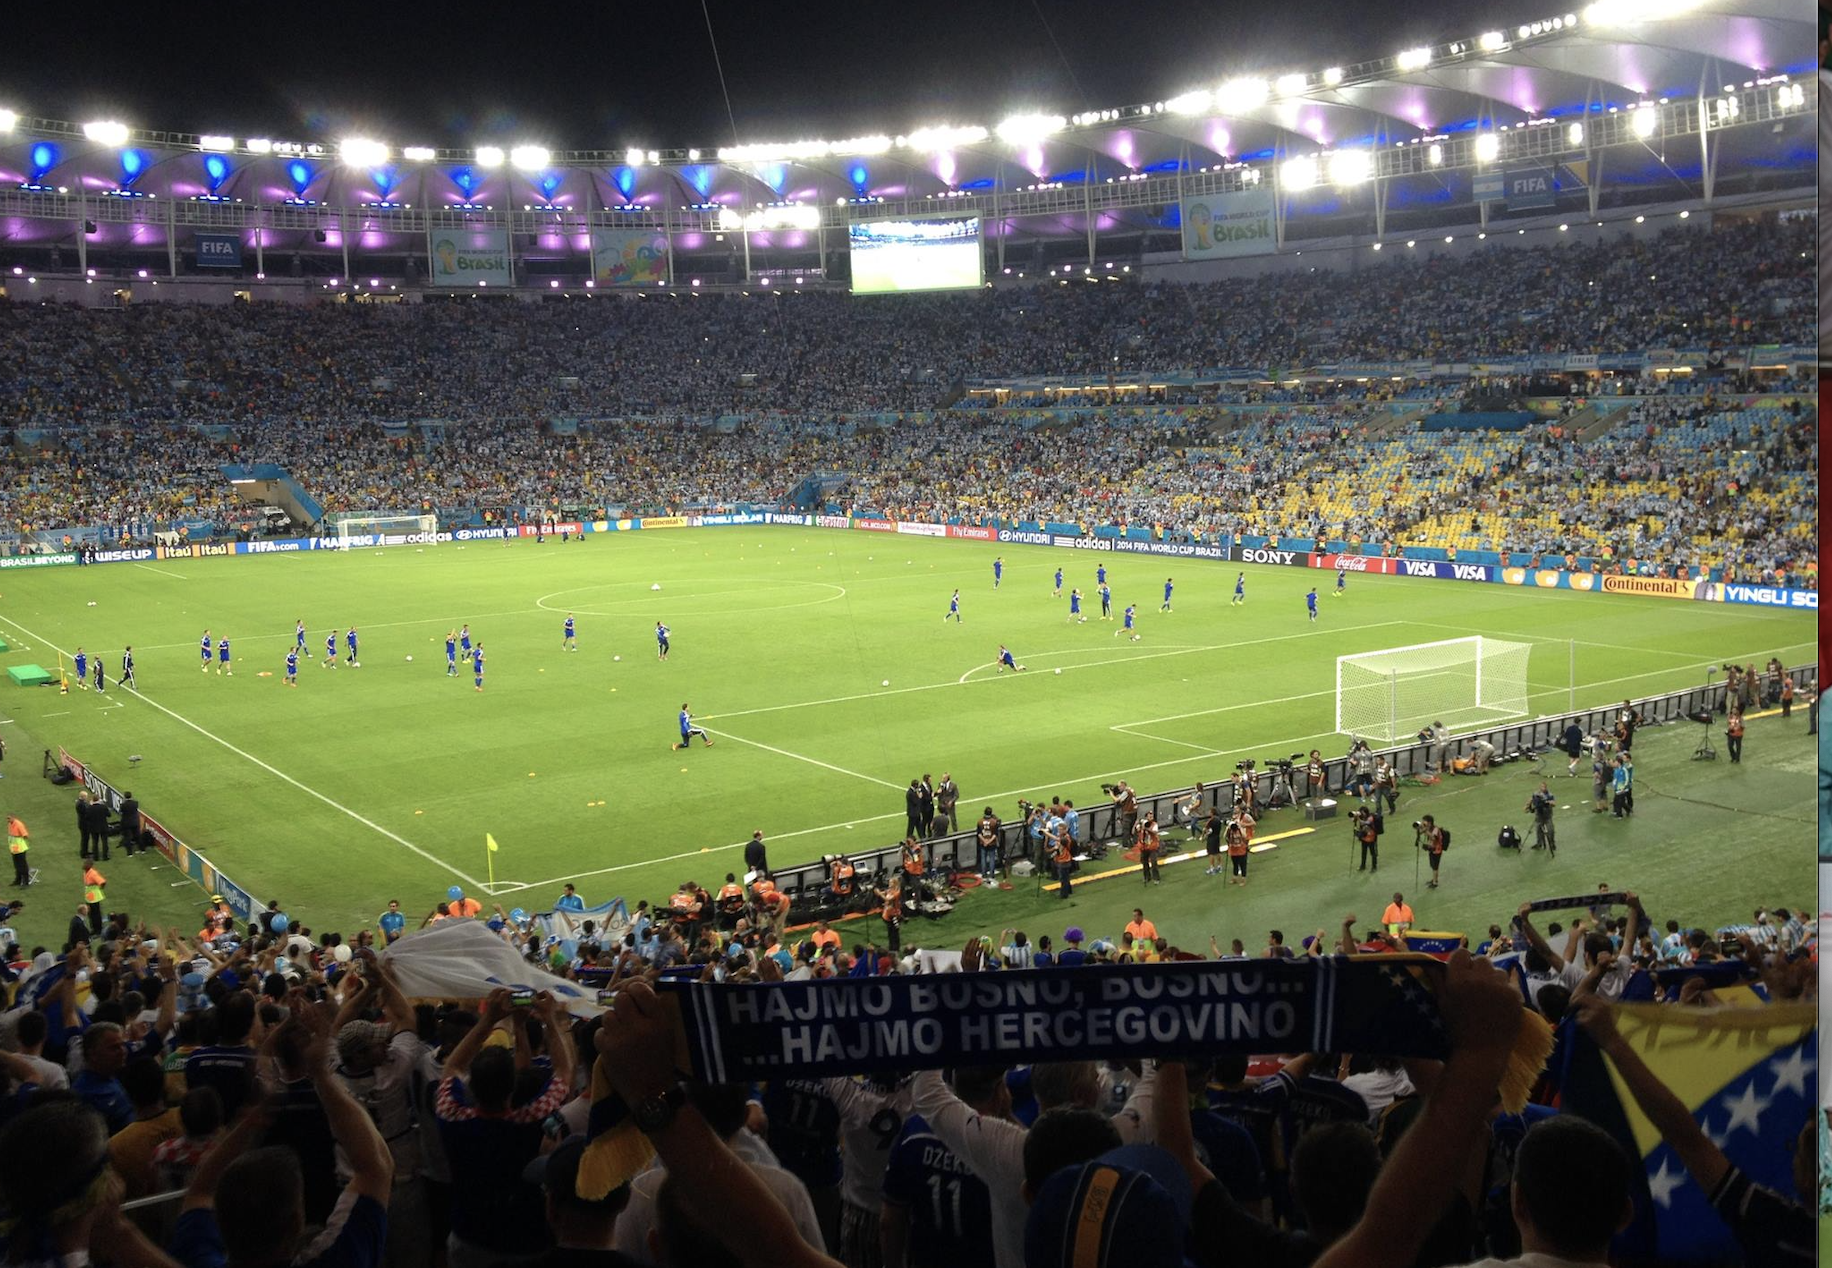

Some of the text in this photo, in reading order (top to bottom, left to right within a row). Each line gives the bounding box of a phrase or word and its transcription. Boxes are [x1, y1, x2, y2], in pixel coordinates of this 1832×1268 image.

[1513, 177, 1546, 193] FIFA
[1214, 219, 1269, 242] Brasil
[202, 242, 234, 254] FIFA
[457, 257, 505, 270] Brasil
[642, 518, 680, 528] Continental
[406, 532, 453, 543] adidas
[1012, 530, 1050, 545] HYUNDAI
[1075, 537, 1112, 551] adidas
[1116, 540, 1133, 550] 2014
[1133, 541, 1149, 551] FIFA
[1150, 543, 1178, 554] WORLD
[1179, 545, 1194, 554] CUP
[165, 545, 191, 558] Itaú
[201, 544, 227, 556] Itaú
[247, 541, 299, 553] FIFA.com
[1242, 550, 1296, 565] SONY
[1404, 560, 1437, 577] VISA
[1451, 564, 1486, 581] VISA
[1603, 576, 1678, 595] Continental
[84, 769, 107, 800] SONY
[727, 984, 893, 1025] HAJMO
[909, 979, 1084, 1013] BOSNO,
[960, 1000, 1296, 1052] HERCEGOVINO
[926, 1174, 964, 1238] 11
